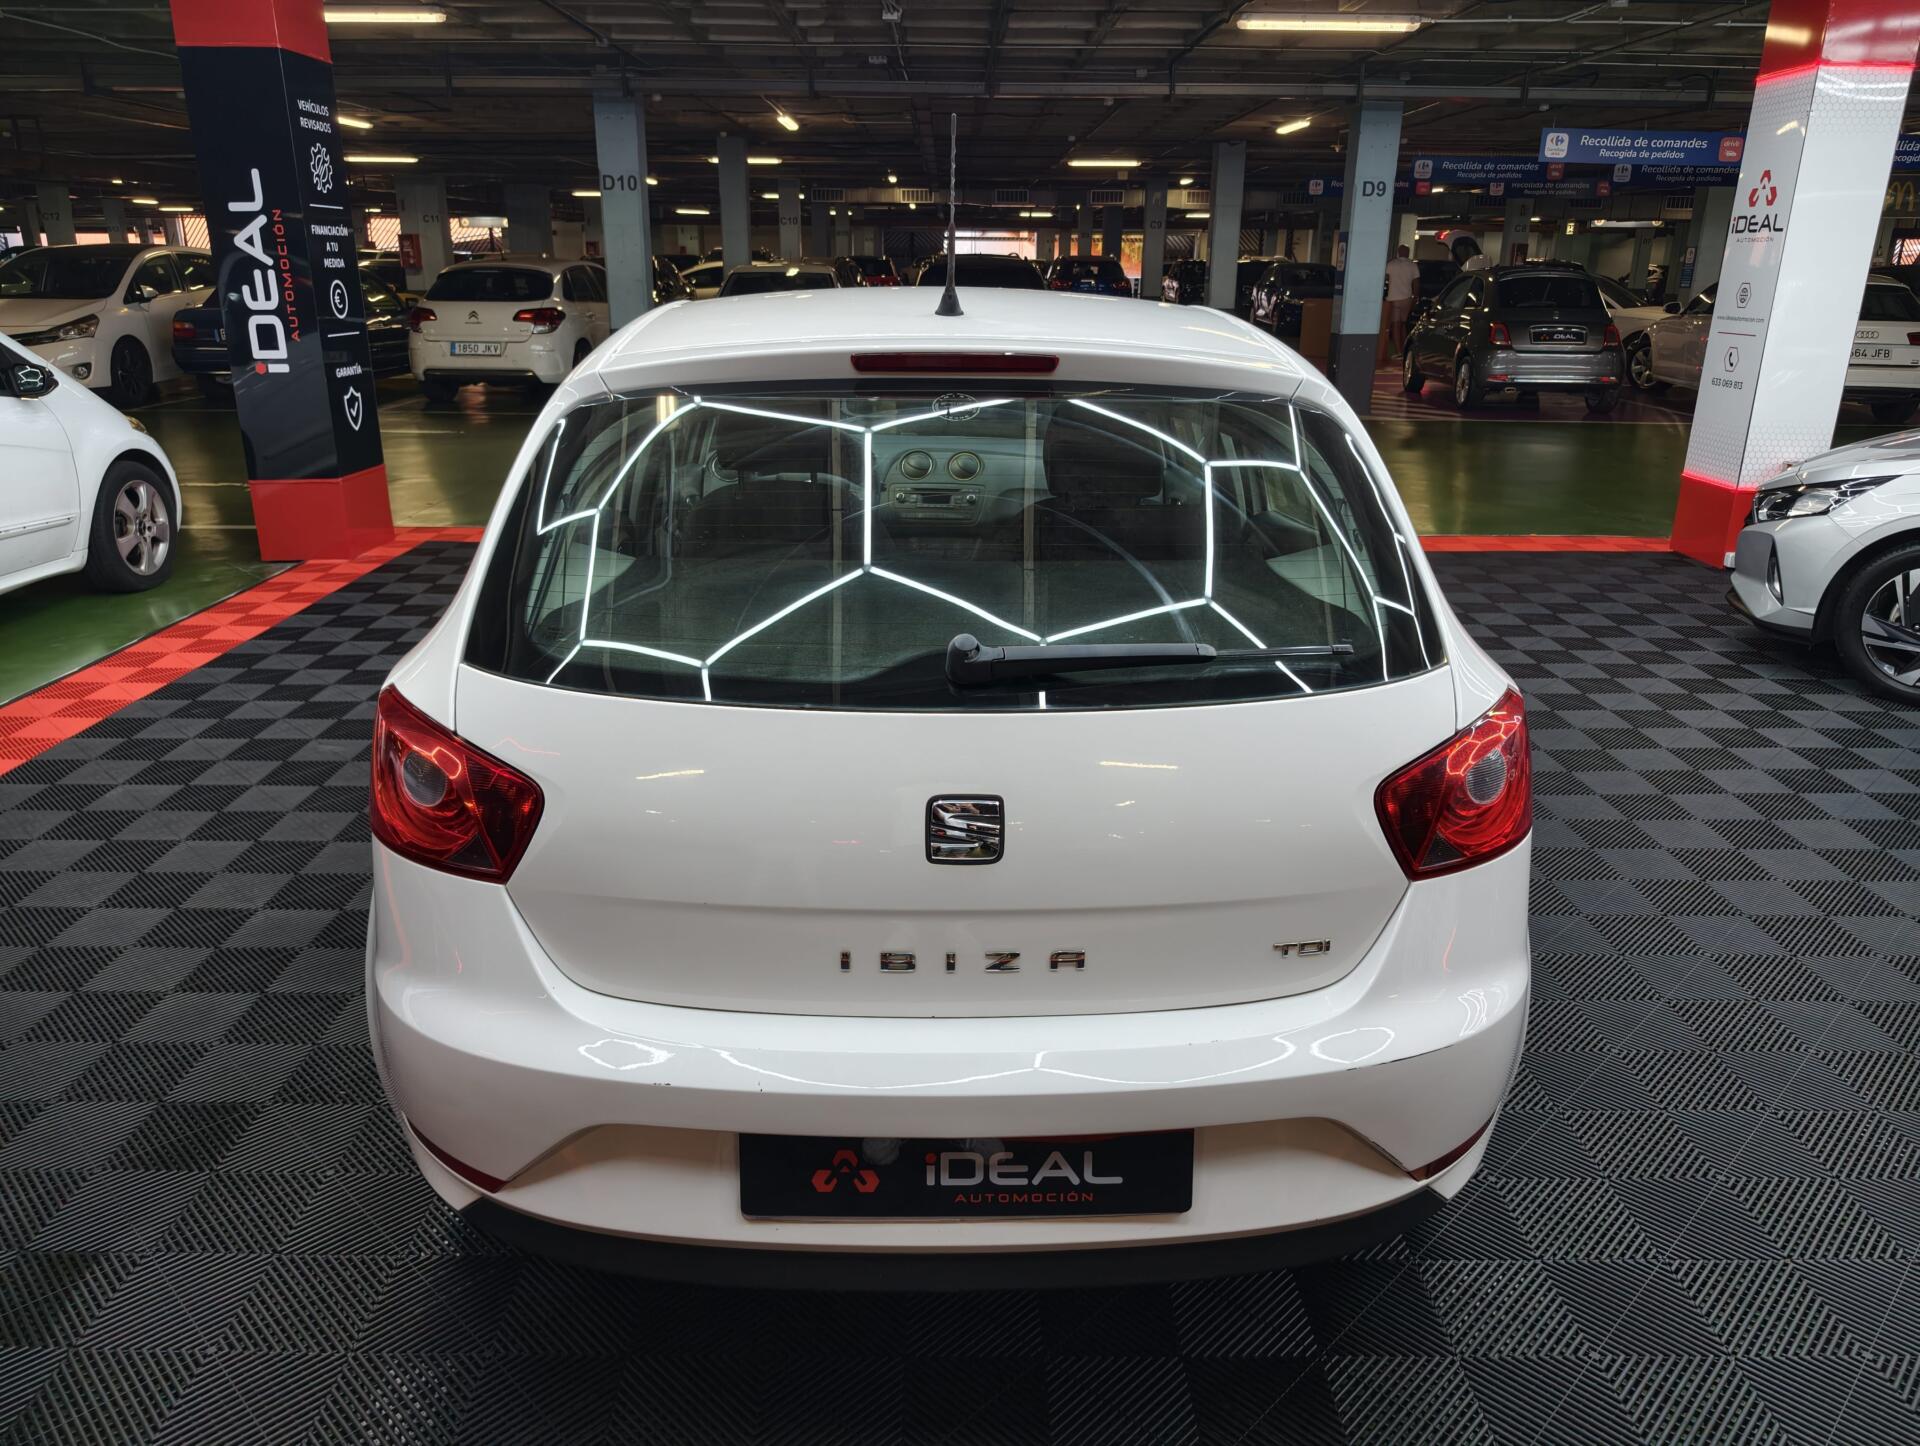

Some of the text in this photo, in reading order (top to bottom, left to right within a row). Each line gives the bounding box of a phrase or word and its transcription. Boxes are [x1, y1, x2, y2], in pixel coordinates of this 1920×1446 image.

[297, 99, 329, 117] VEHÍCULOS
[300, 117, 331, 133] REVISADOS
[1581, 135, 1708, 149] Recollida de comandes
[1600, 149, 1685, 160] Recogida de pedidos
[1442, 161, 1539, 171] Recollida de comandes
[1641, 164, 1680, 174] Recollida
[1684, 165, 1694, 174] de
[602, 174, 637, 192] D10
[1362, 181, 1387, 197] D9
[423, 215, 440, 223] C11
[780, 216, 798, 226] C10
[1731, 213, 1784, 234] iDEAL
[311, 224, 349, 237] FINANCIACIÓN
[326, 243, 339, 252] A TU
[324, 258, 346, 269] MEDIDA
[228, 168, 290, 375] iDEAL
[272, 209, 301, 342] AUTOMOCIÓN
[458, 344, 499, 353] 1850 JKV
[1871, 349, 1890, 359] JFB
[336, 363, 362, 378] GARANTÍA
[1711, 377, 1743, 390] 633 069 813
[1273, 938, 1330, 958] TDI
[840, 949, 1086, 973] IBIZA
[925, 1150, 1123, 1187] iDEAL
[954, 1190, 1094, 1203] AUTOMOCIÓN
